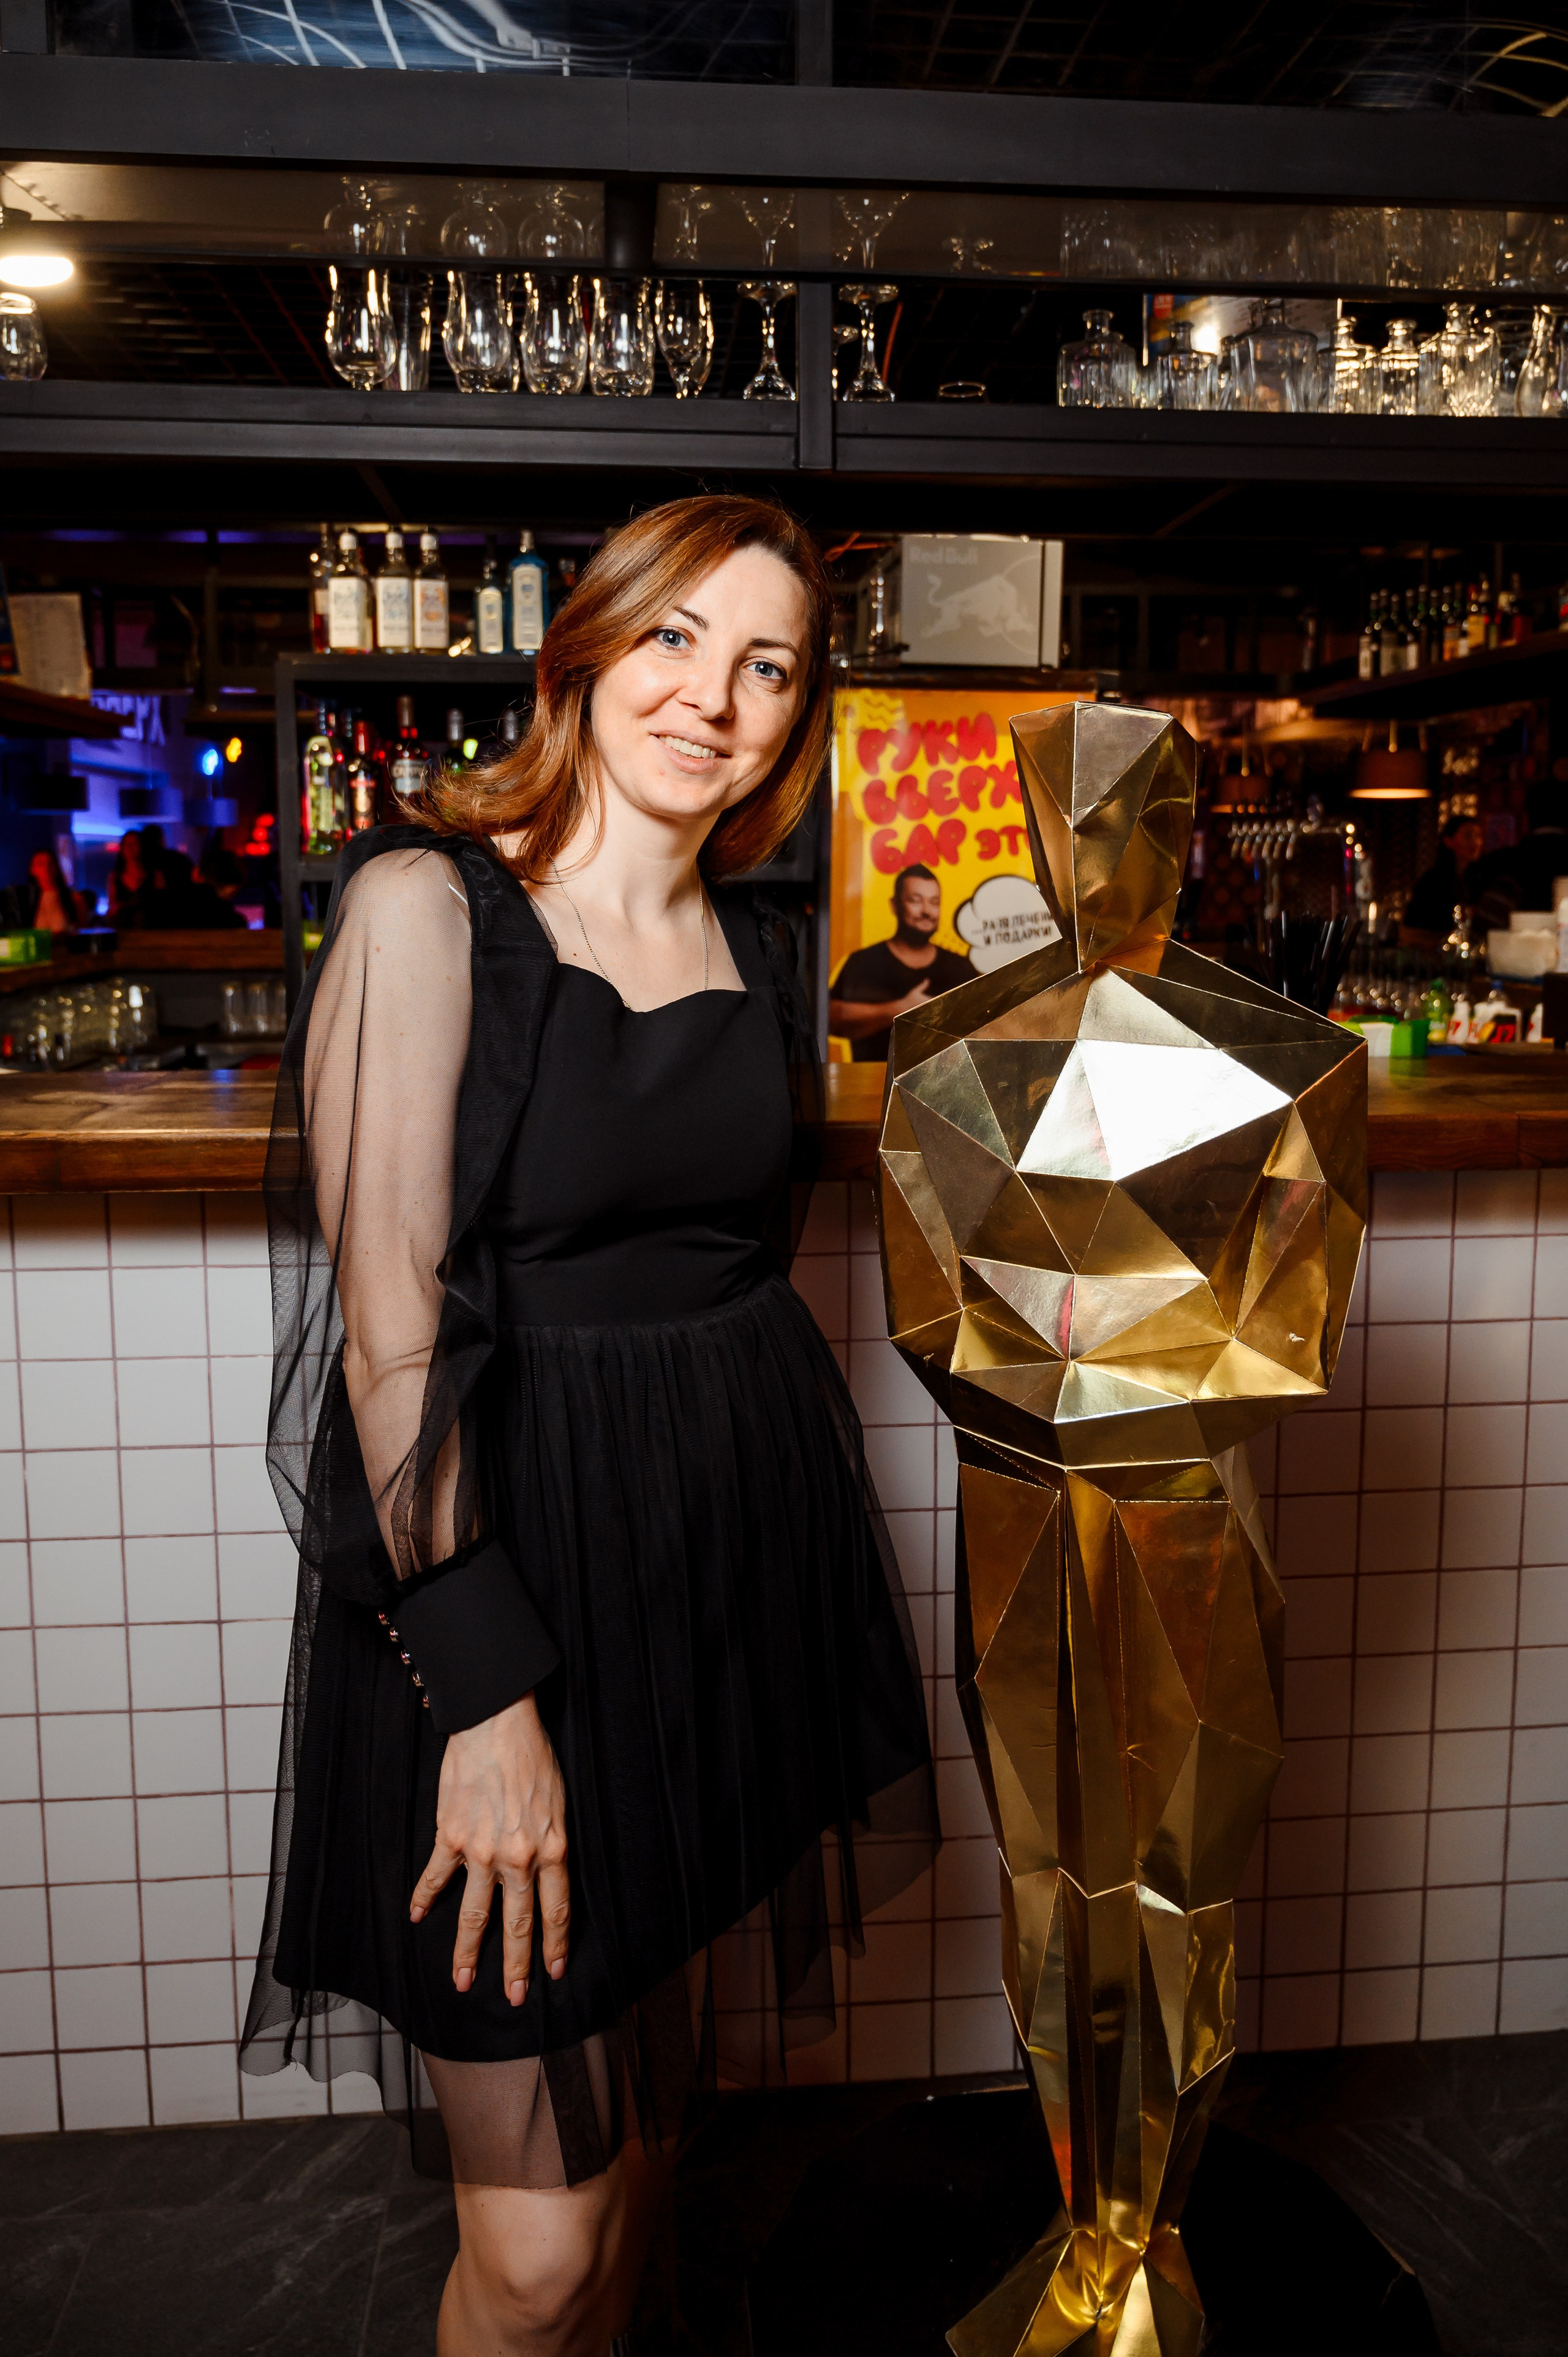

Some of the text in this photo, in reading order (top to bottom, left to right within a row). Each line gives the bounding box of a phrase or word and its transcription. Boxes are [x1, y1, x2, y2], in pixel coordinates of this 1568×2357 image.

[858, 712, 997, 776] РУКИ
[870, 819, 1030, 874] БАР ЭТ
